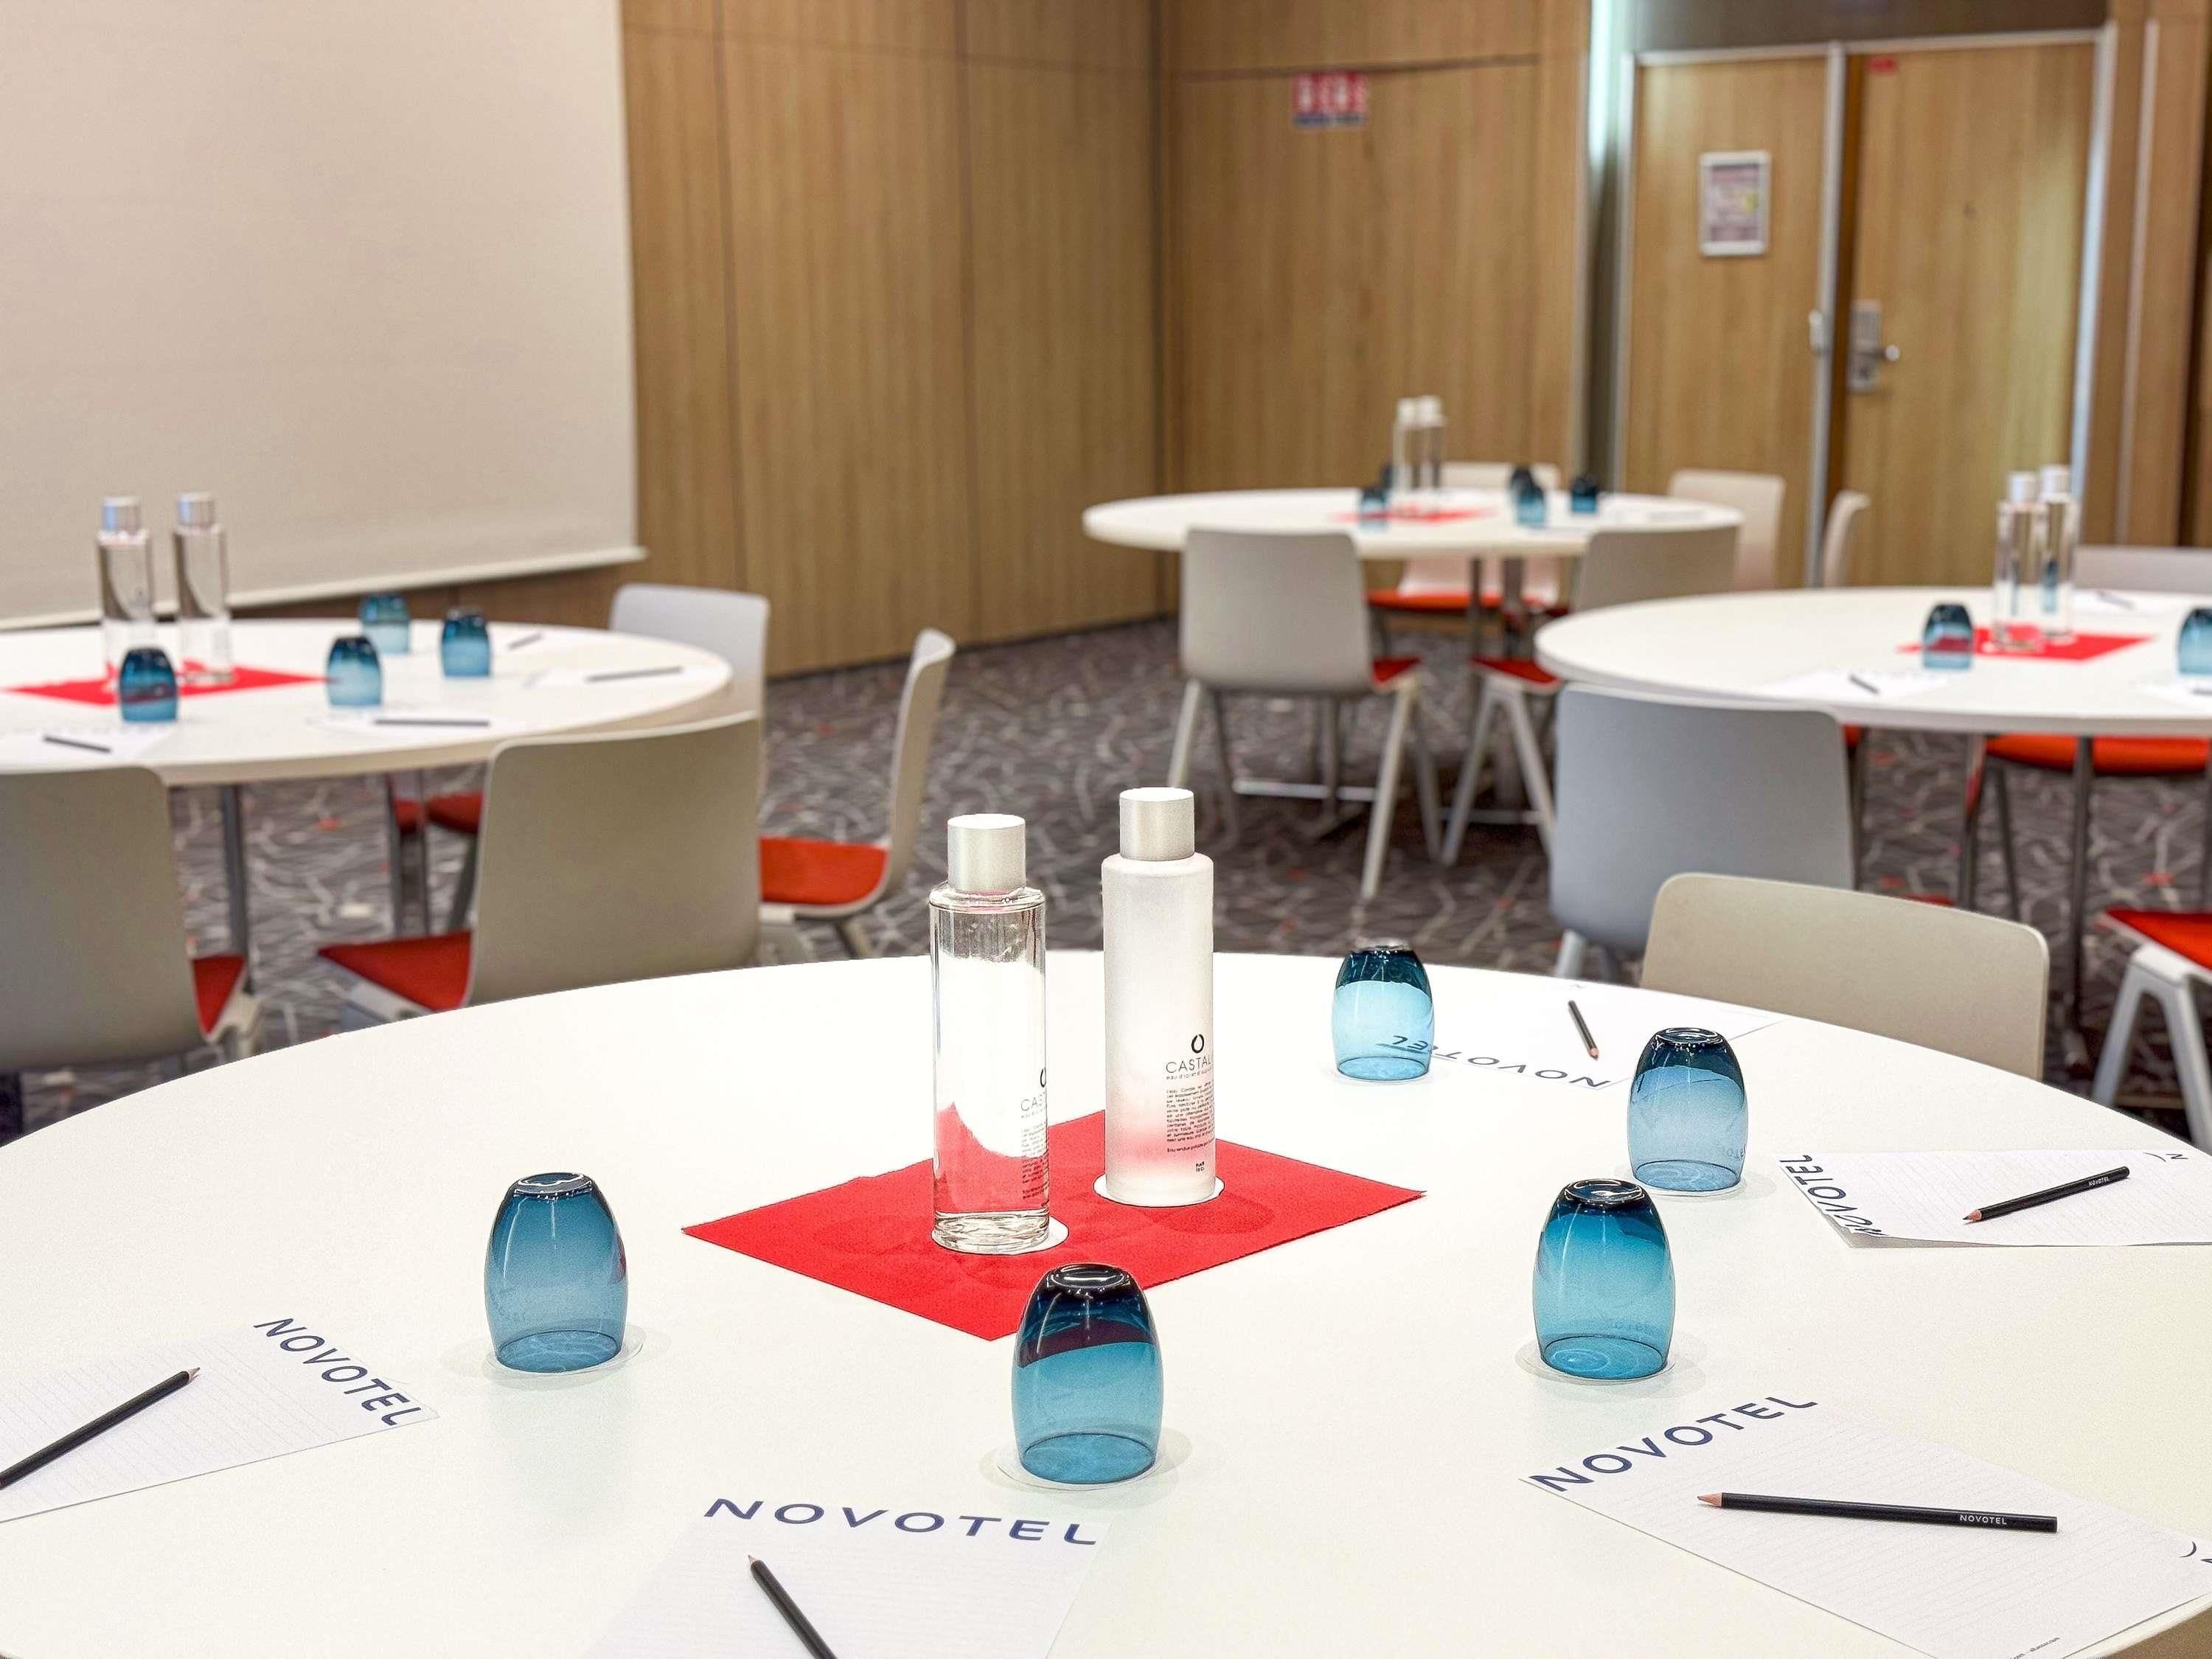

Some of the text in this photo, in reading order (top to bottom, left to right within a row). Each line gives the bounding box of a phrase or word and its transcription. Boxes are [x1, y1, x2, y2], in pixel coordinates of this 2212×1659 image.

[1392, 1034, 1611, 1088] NOVOTEL
[1778, 1154, 1891, 1237] NOVOTEL
[253, 1318, 422, 1426] NOVOTEL
[1528, 1397, 1818, 1492] NOVOTEL
[704, 1498, 1096, 1545] NOVOTEL
[1959, 1514, 2008, 1525] NOVOTEL
